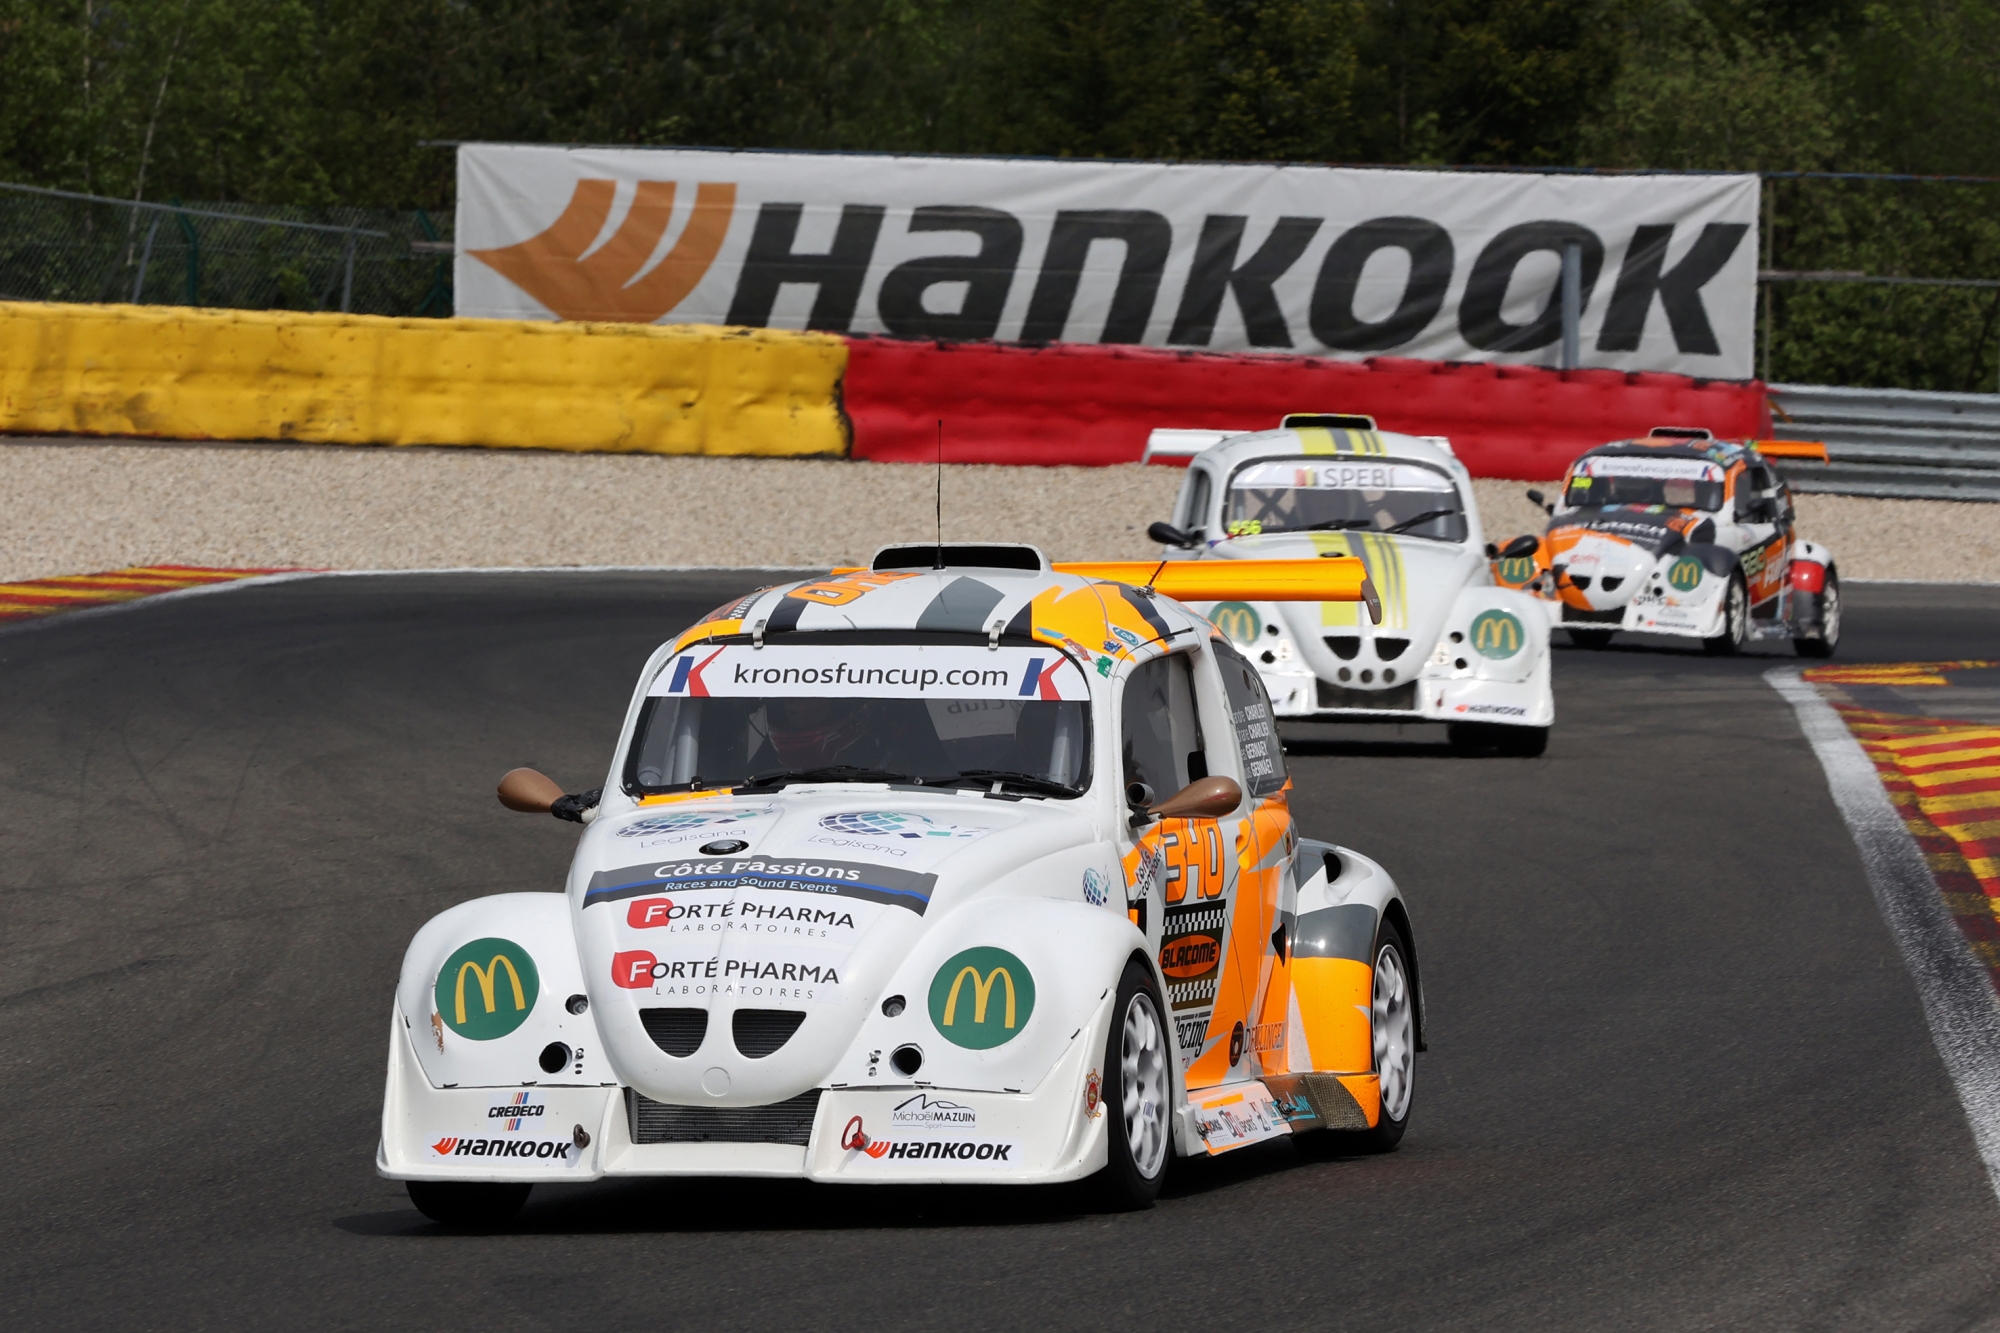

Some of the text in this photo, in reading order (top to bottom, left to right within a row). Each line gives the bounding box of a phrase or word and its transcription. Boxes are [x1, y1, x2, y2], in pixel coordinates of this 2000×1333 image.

[733, 662, 1009, 691] kronosfuncup.com
[640, 829, 746, 849] Legisana
[807, 834, 908, 857] Legisana
[654, 859, 861, 881] Côté Passions
[1160, 818, 1225, 905] 340
[665, 876, 838, 894] Races and Sound Events
[740, 902, 855, 929] PHARMA
[670, 921, 827, 938] LABORATOIRES
[1161, 941, 1217, 970] BLACOME
[724, 959, 840, 984] PHARMA
[655, 984, 814, 1000] LABORATOIRES
[1174, 1014, 1210, 1057] acing
[488, 1105, 545, 1118] CREDECO
[924, 1121, 942, 1130] Sport
